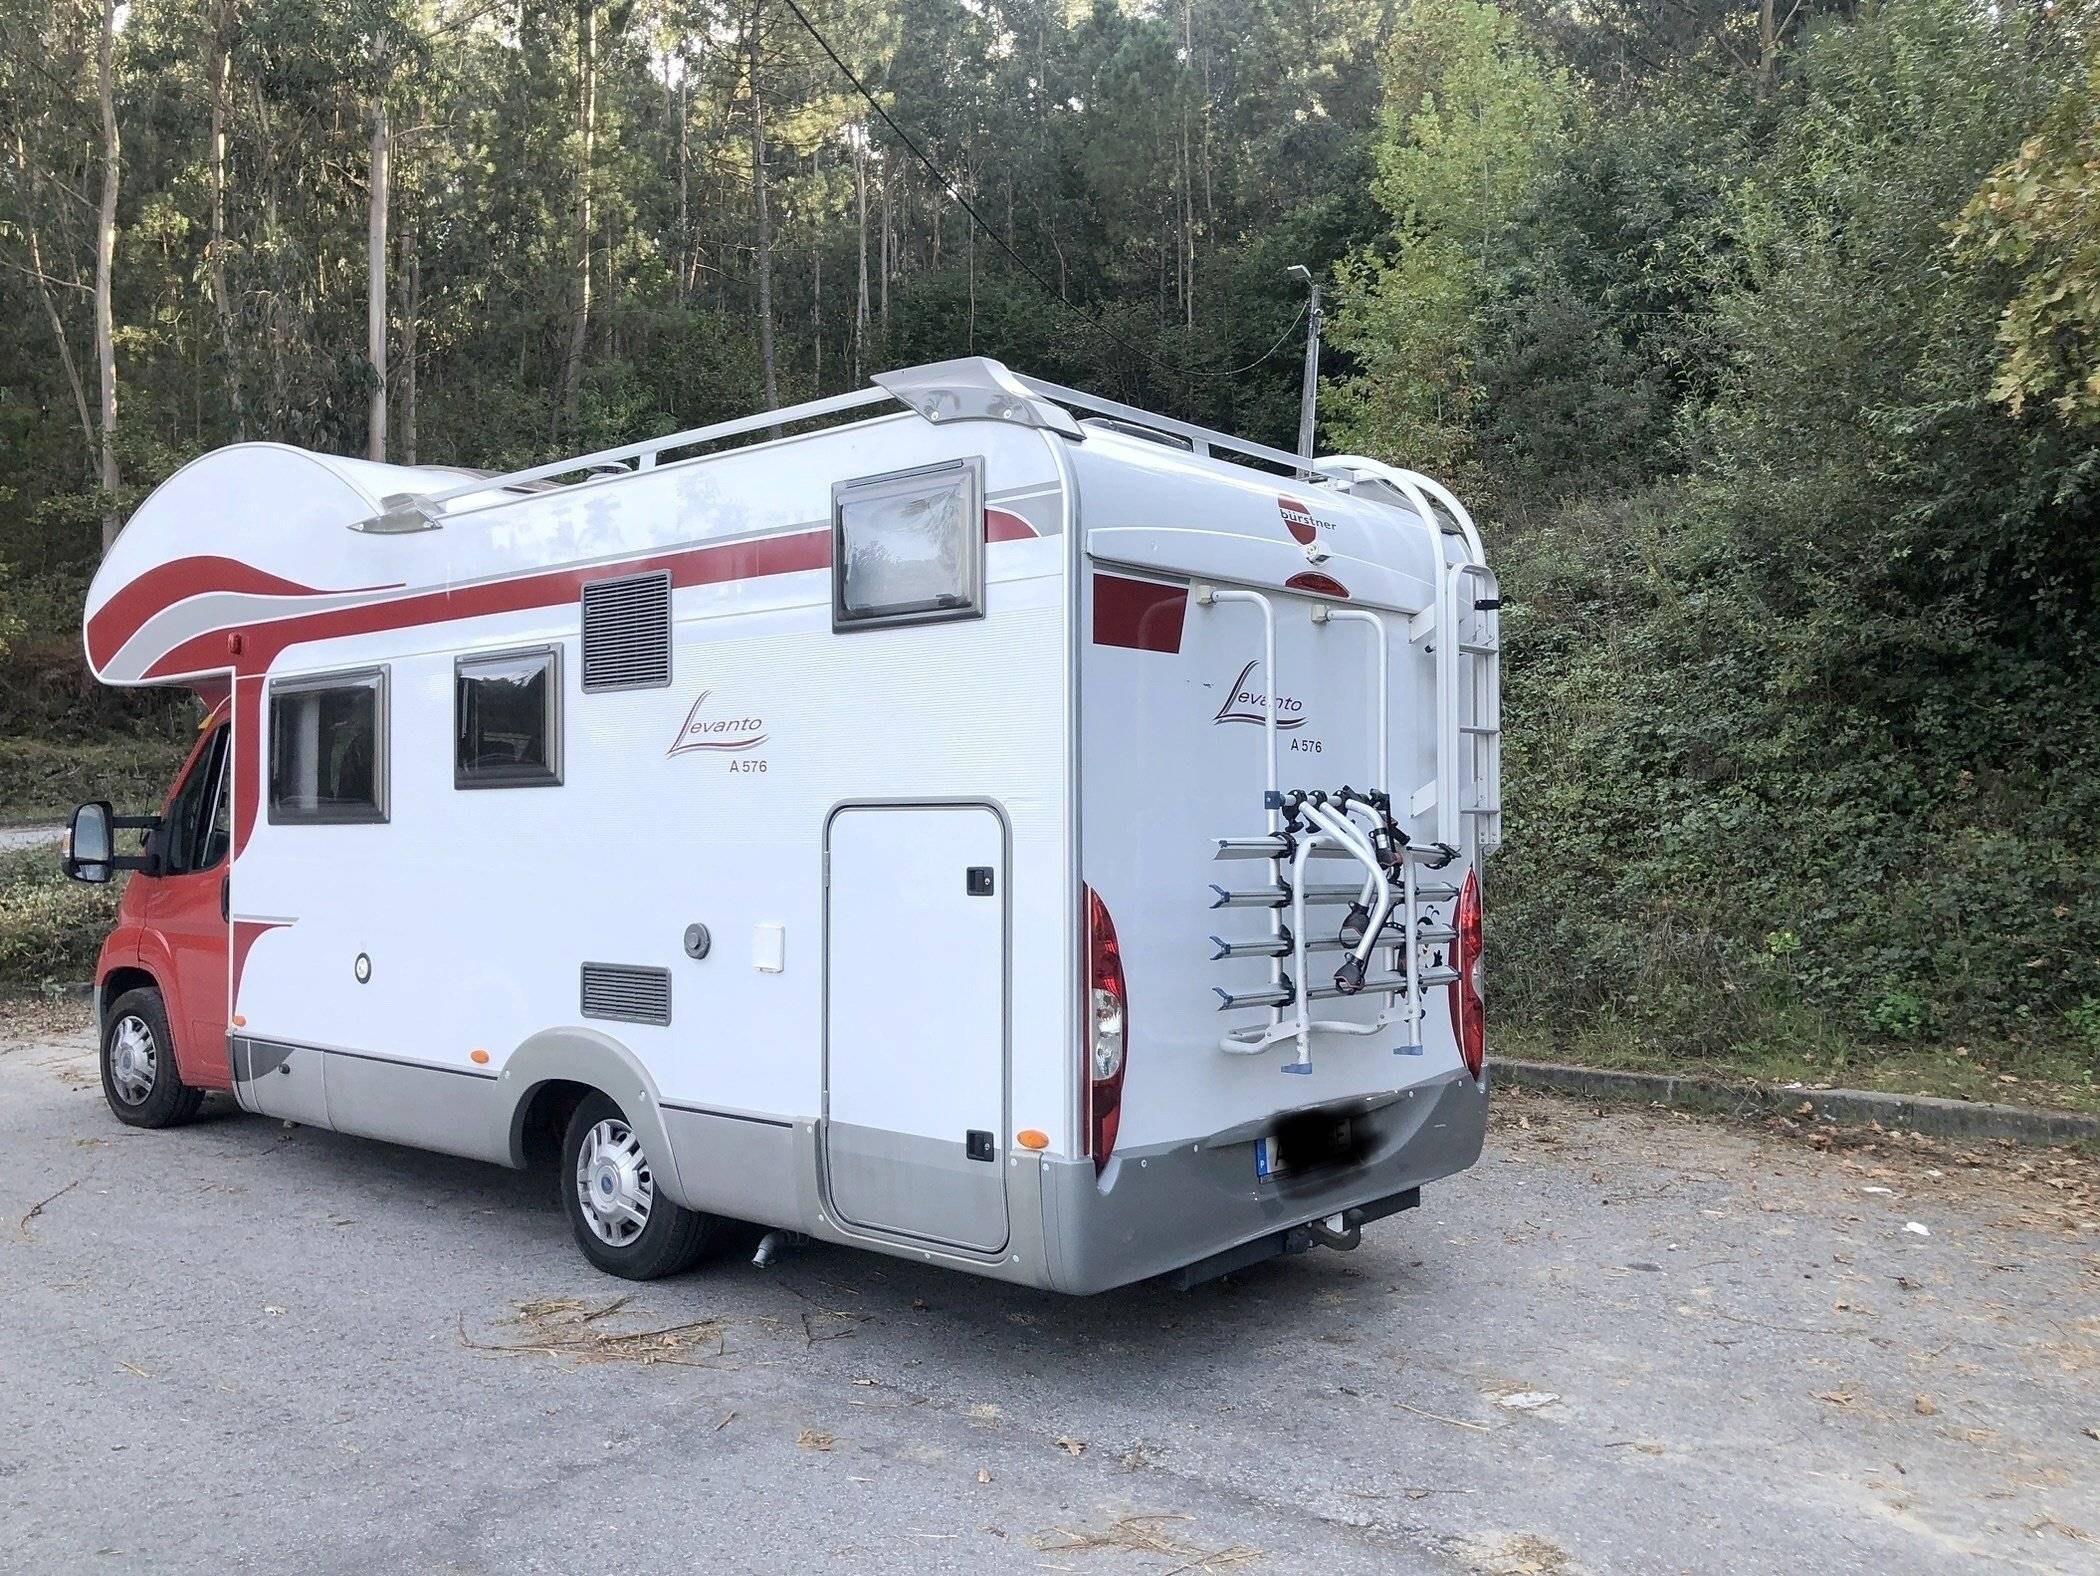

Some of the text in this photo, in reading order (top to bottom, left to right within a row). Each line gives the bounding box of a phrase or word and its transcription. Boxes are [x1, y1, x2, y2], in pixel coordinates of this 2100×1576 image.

[1279, 508, 1337, 531] bürstner
[665, 689, 769, 760] Levanto
[1290, 738, 1322, 753] A 576
[729, 759, 768, 773] A 576
